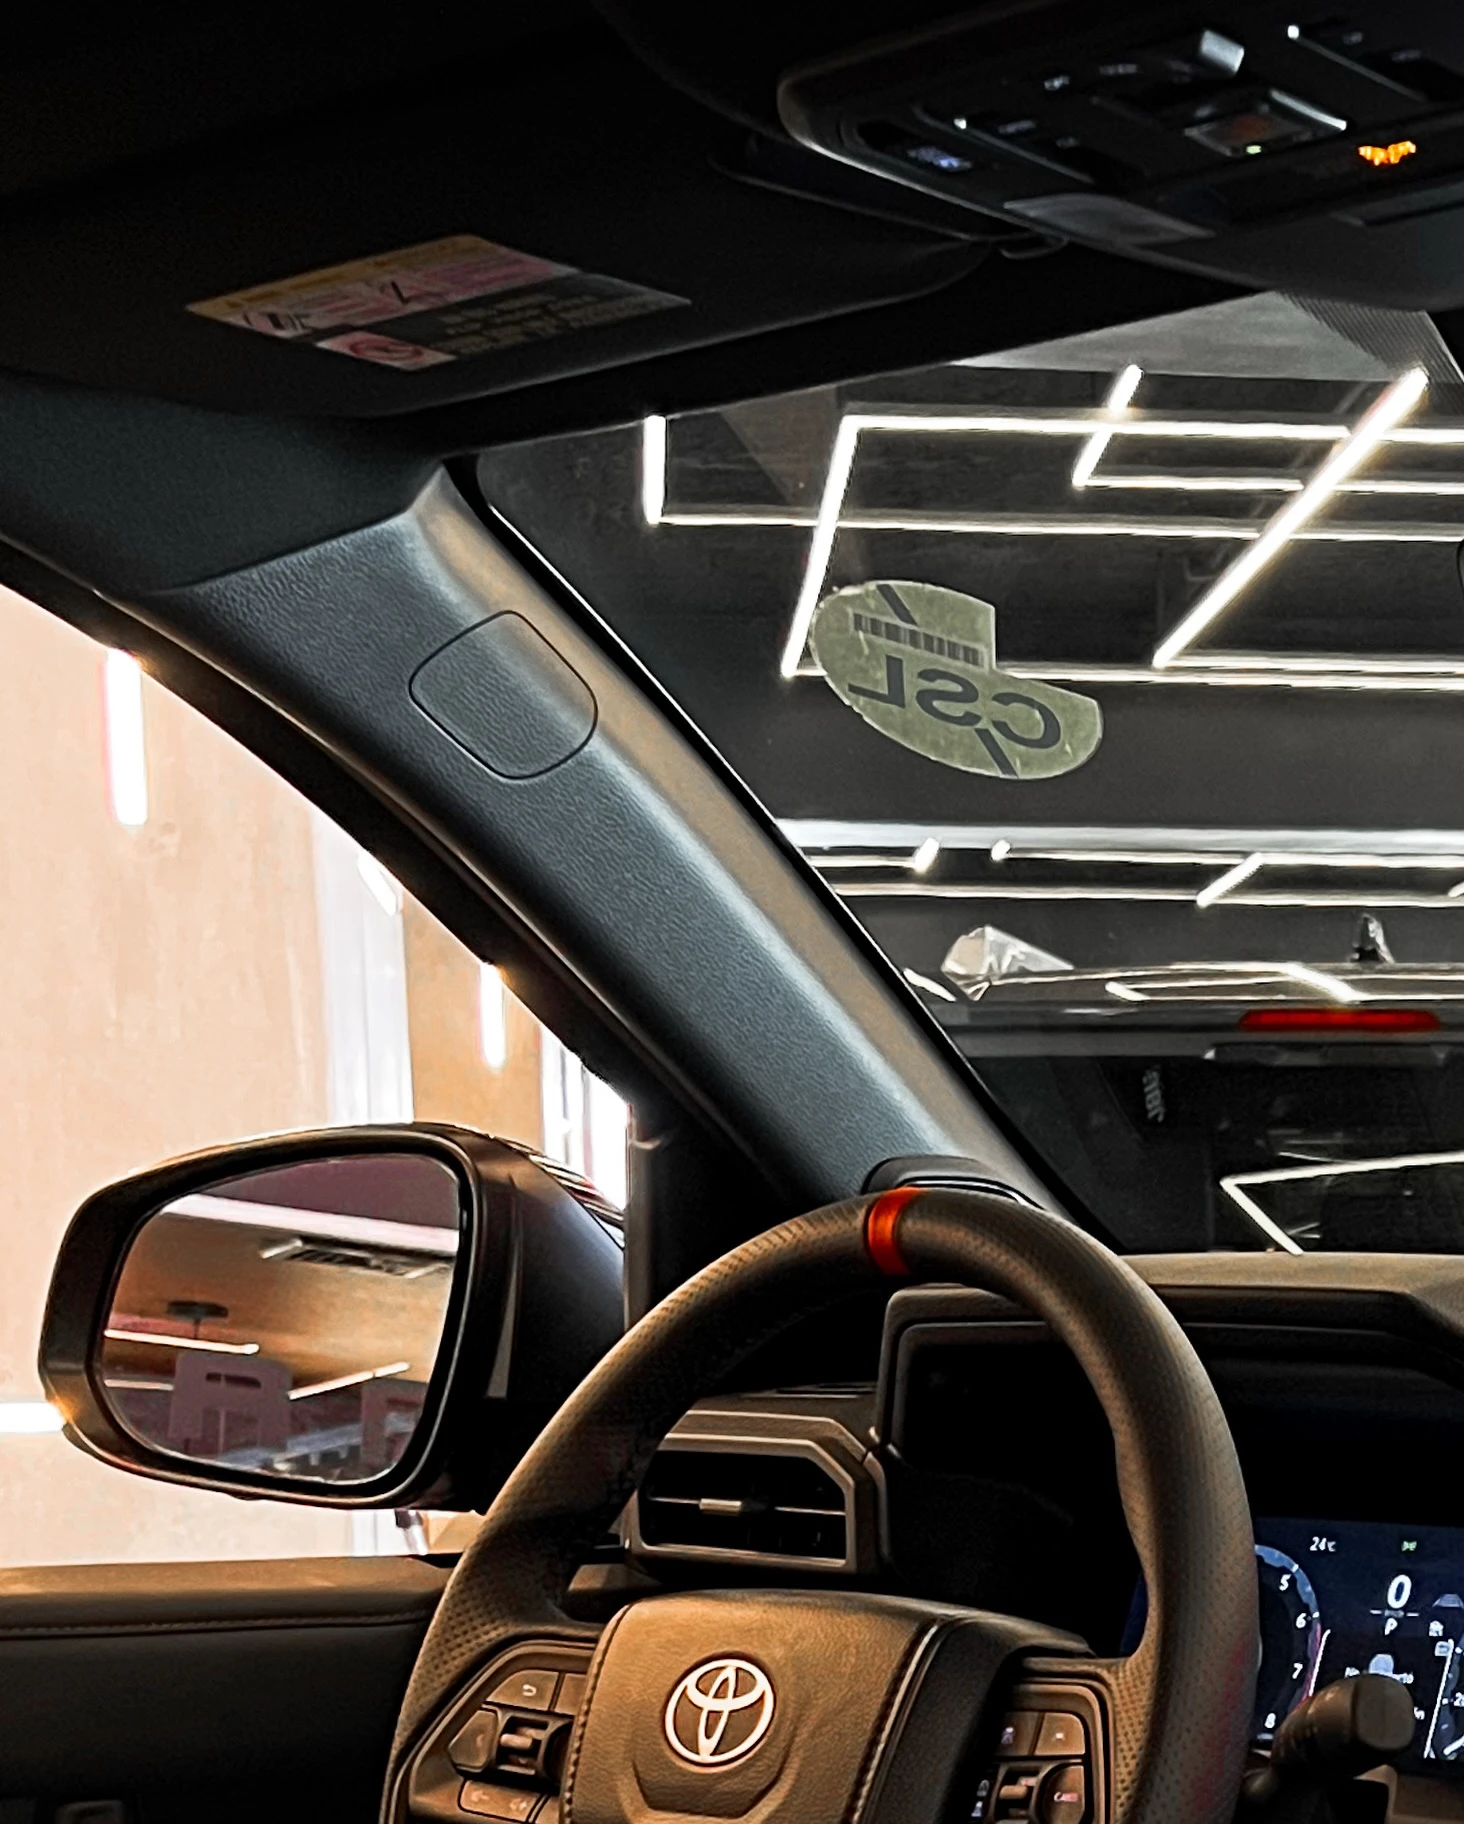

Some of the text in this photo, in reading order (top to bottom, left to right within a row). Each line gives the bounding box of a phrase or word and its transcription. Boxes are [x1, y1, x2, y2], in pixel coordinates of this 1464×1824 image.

[1279, 1574, 1292, 1591] 5
[1387, 1574, 1412, 1609] 0
[1295, 1612, 1307, 1629] 6
[1384, 1617, 1398, 1636] P
[1292, 1663, 1303, 1680] 7
[1264, 1713, 1276, 1729] 8
